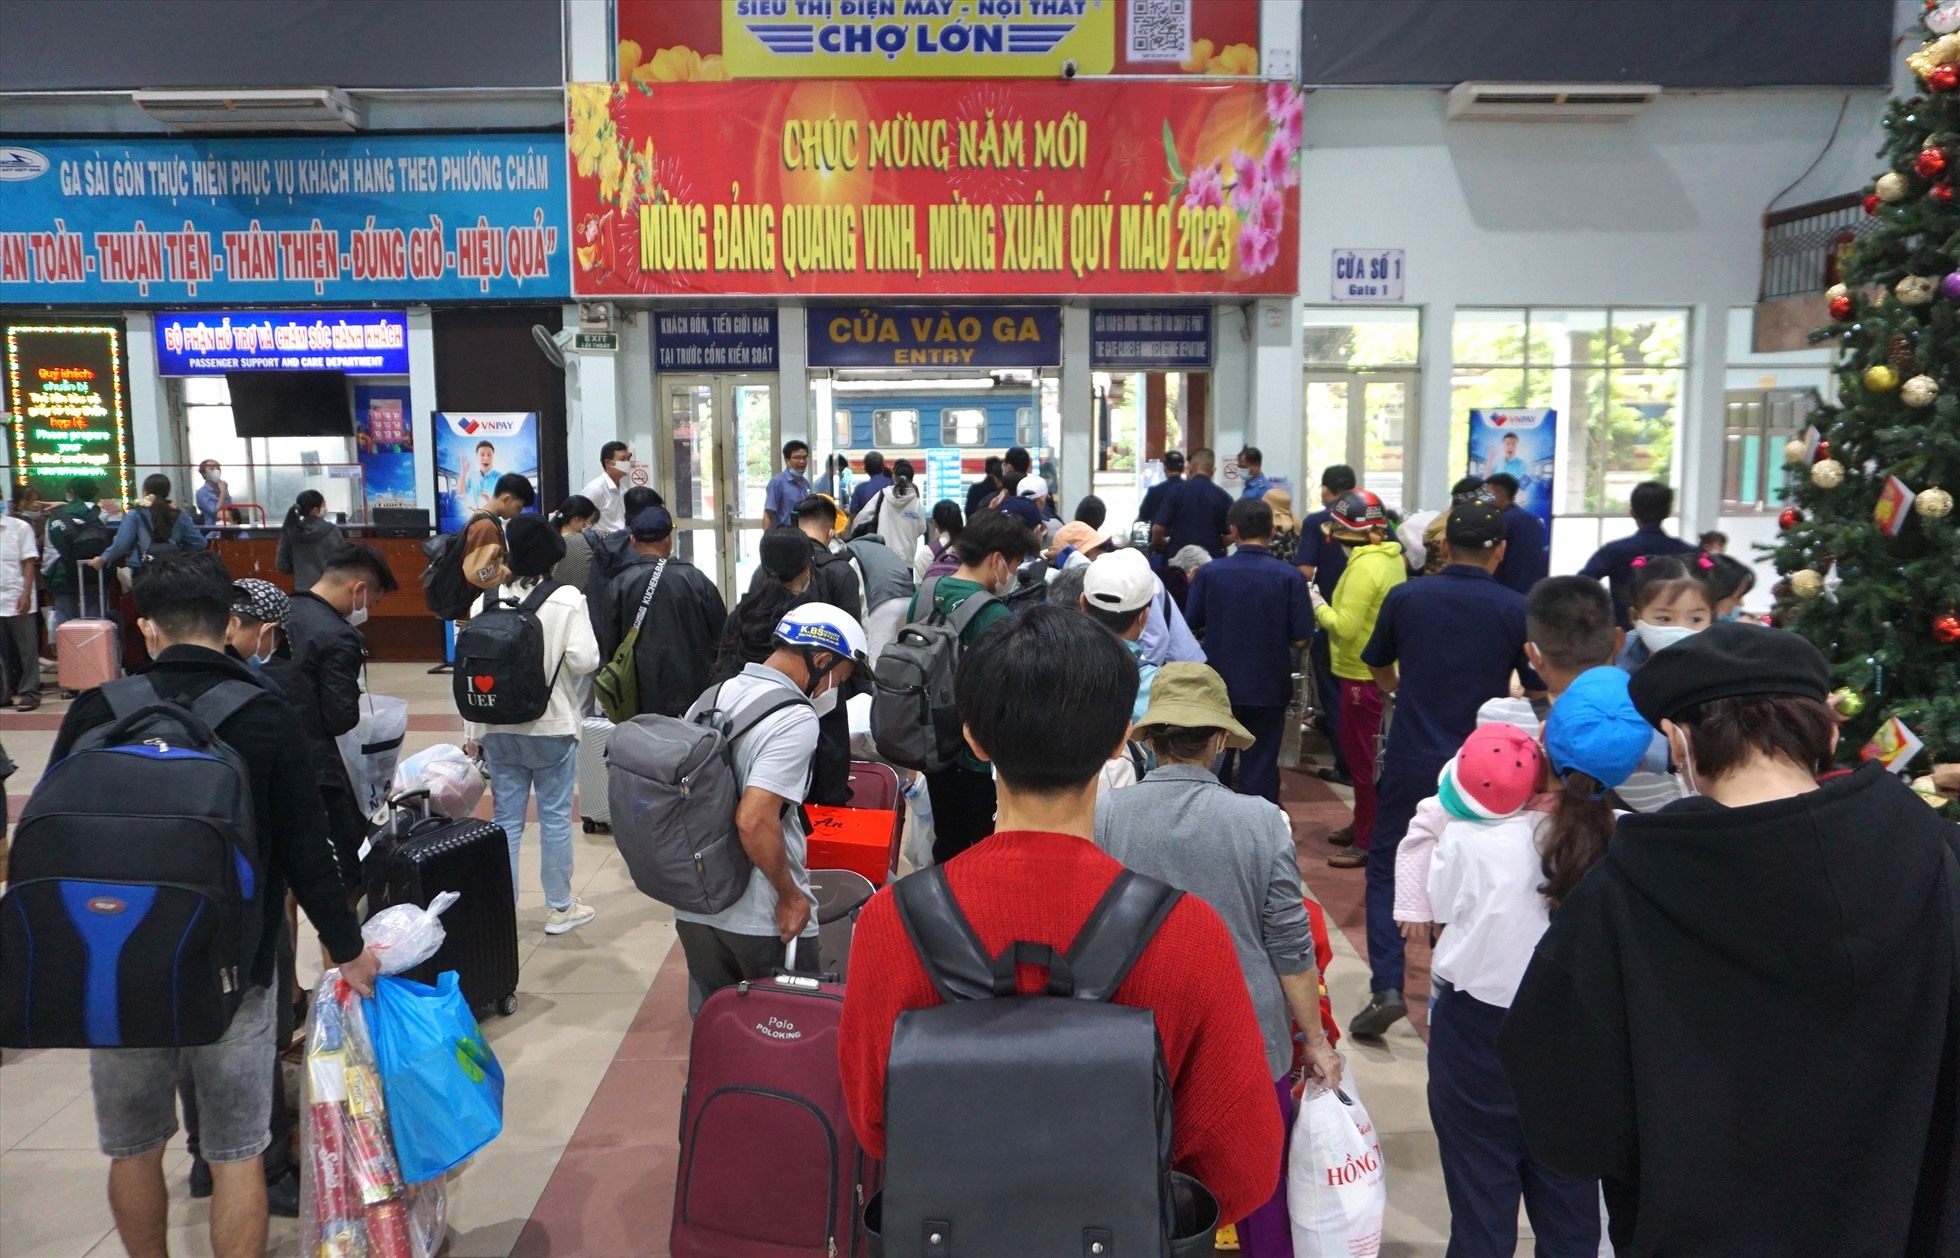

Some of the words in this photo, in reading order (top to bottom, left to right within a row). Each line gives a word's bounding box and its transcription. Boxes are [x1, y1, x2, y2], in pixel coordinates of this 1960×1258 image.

[818, 24, 908, 59] CHỢ
[917, 19, 1002, 52] LỚN
[782, 111, 859, 170] CHÚC
[868, 110, 949, 170] MỪNG
[959, 107, 1025, 168] NĂM
[1034, 110, 1087, 169] MỚI
[60, 160, 82, 196] GA
[84, 150, 110, 196] SÀI
[113, 151, 144, 196] GÒN
[148, 154, 189, 206] THỰC
[191, 153, 228, 206] HIỆN
[231, 160, 271, 205] PHỤC
[274, 160, 294, 205] VỤ
[298, 150, 349, 194] KHÁCH
[353, 148, 394, 193] HÀNG
[398, 156, 438, 192] THEO
[441, 149, 501, 191] PHƯƠNG
[506, 146, 548, 190] CHÂM
[640, 189, 707, 272] MỪNG
[713, 181, 775, 272] ĐẢNG
[782, 203, 856, 279] QUANG
[862, 204, 923, 279] VINH,
[928, 189, 995, 271] MỪNG
[1002, 189, 1064, 271] XUÂN
[1070, 189, 1113, 279] QUÝ
[1120, 190, 1170, 272] MÃO
[1176, 204, 1231, 272] 2023
[0, 232, 29, 283] AN
[30, 218, 85, 284] TOÀN
[86, 255, 96, 273] -
[95, 220, 164, 297] THUẬN
[163, 220, 213, 297] TIỆN
[213, 255, 223, 272] -
[222, 219, 279, 283] THÂN
[278, 218, 340, 295] THIỆN
[341, 253, 351, 271] -
[350, 215, 408, 281] ĐÚNG
[408, 214, 444, 280] GIỜ
[446, 251, 456, 268] -
[456, 215, 504, 292] HIỆU
[1337, 251, 1365, 279] CỬA
[1371, 251, 1390, 279] SỐ
[1395, 258, 1401, 279] 1
[1349, 284, 1377, 296] Gate
[1382, 285, 1388, 296] 1
[165, 321, 184, 355] BỘ
[183, 321, 216, 355] PHẬN
[215, 317, 233, 350] HỖ
[233, 324, 256, 353] TRỢ
[256, 320, 274, 350] VÀ
[274, 321, 308, 351] CHĂM
[308, 320, 332, 349] SÓC
[332, 319, 363, 350] HÀNH
[364, 319, 403, 349] KHÁCH
[660, 316, 690, 334] KHÁCH
[690, 315, 710, 335] ĐÓN,
[733, 313, 751, 334] GIỚI
[752, 316, 769, 337] HẠN
[828, 308, 899, 343] CỬA
[910, 311, 982, 342] VÀO
[992, 317, 1040, 342] GA
[189, 358, 239, 368] PASSENGER
[240, 358, 279, 368] SUPPORT
[281, 357, 299, 367] AND
[300, 357, 324, 367] CARE
[325, 356, 383, 367] DEPARTMENT
[660, 347, 674, 367] TẠI
[676, 344, 702, 364] TRƯỚC
[704, 341, 726, 364] CỔNG
[728, 341, 750, 364] KIỂM
[751, 344, 773, 364] SOÁT
[894, 349, 975, 364] ENTRY
[481, 421, 514, 429] VNPAY
[466, 675, 475, 693] I
[467, 693, 497, 706] UEF
[813, 817, 844, 829] An
[756, 1023, 801, 1039] POLOKING
[768, 1016, 794, 1030] Polo
[1326, 1151, 1378, 1186] HỒNG
